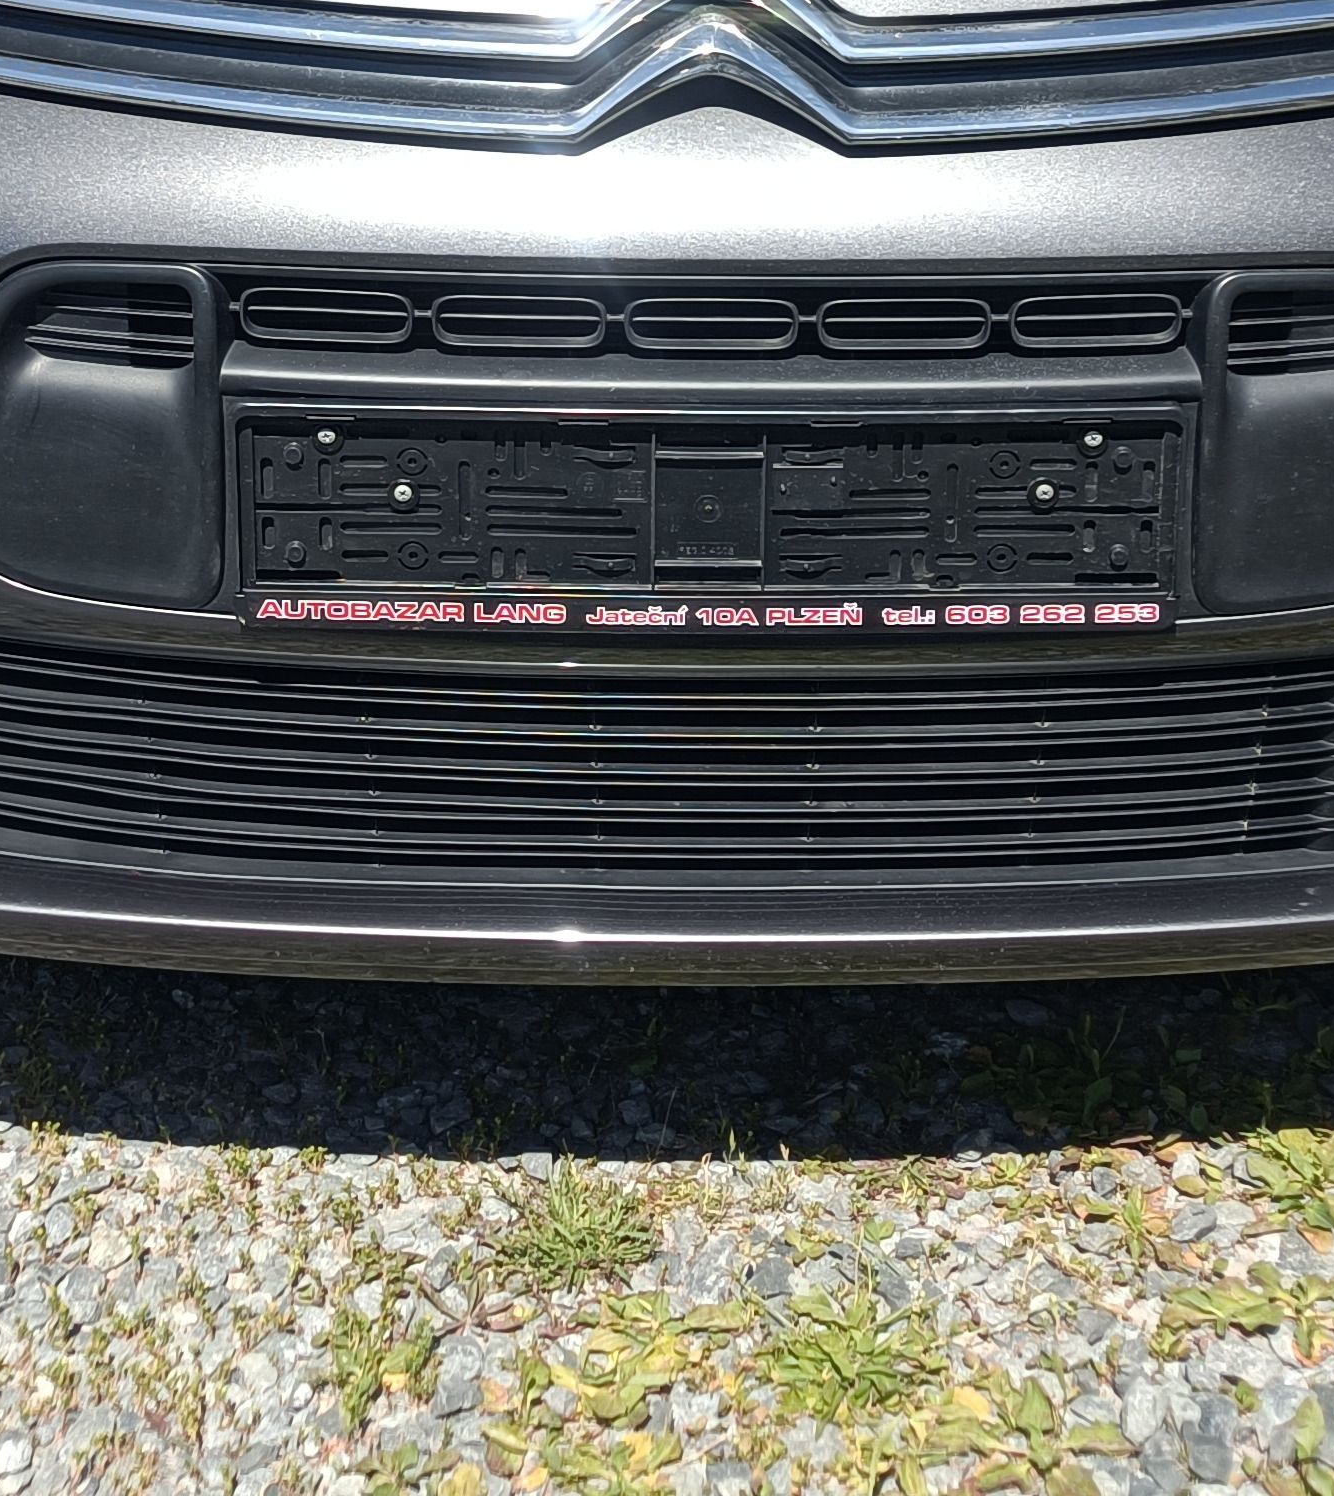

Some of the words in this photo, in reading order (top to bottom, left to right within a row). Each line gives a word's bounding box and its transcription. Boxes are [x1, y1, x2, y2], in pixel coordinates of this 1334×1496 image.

[257, 599, 464, 622] AUTOBAZAR
[473, 602, 566, 624] LANG
[585, 605, 688, 625] Jateční
[695, 607, 759, 626] 10A
[766, 602, 863, 625] PLZEŇ
[881, 606, 935, 625] tel.:
[944, 605, 1010, 624] 603
[1019, 604, 1085, 624] 262
[1094, 603, 1160, 623] 253
